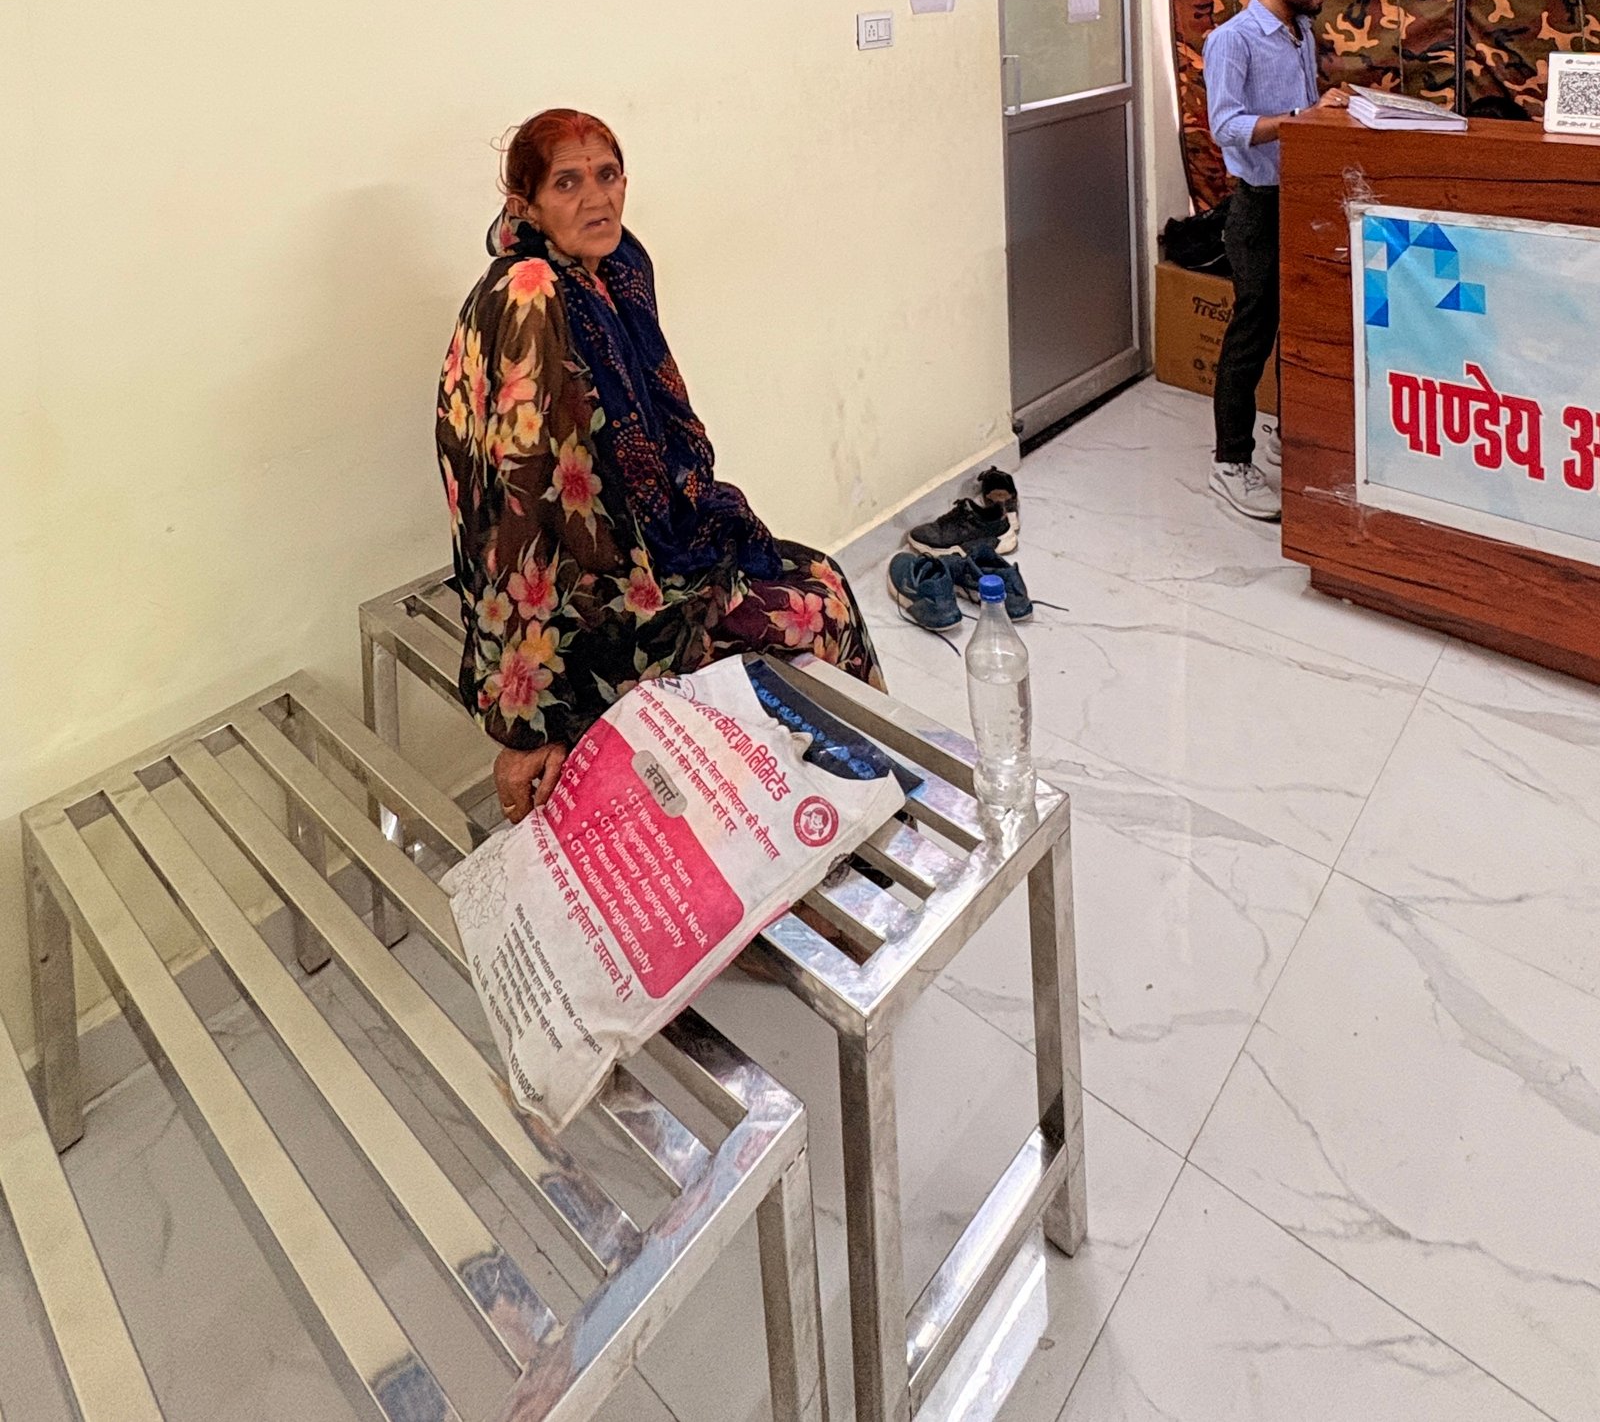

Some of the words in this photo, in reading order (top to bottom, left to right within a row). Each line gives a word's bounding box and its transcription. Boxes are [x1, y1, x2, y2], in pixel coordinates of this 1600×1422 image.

[1388, 362, 1545, 481] पाण्डेय
[644, 763, 679, 807] सेवाएं
[744, 744, 791, 801] लिमिटेड
[691, 745, 710, 767] प्रदेश
[705, 760, 724, 784] जिला
[745, 813, 759, 830] की
[754, 826, 781, 861] सौगात
[713, 801, 730, 821] दरों
[725, 817, 738, 836] पर
[544, 850, 559, 867] की
[628, 793, 643, 809] CT
[638, 807, 658, 835] Whole
[655, 832, 675, 861] Body
[672, 859, 692, 887] Scan
[552, 864, 570, 891] जाँच
[564, 888, 580, 905] की
[585, 828, 600, 844] CT
[594, 843, 616, 873] Renal
[610, 869, 653, 933] Angiography
[600, 816, 615, 833] CT
[609, 831, 642, 878] Pulmonary
[638, 878, 685, 948] Angiography
[614, 805, 629, 820] CT
[622, 821, 663, 877] Angiography
[660, 874, 681, 904] Brain
[678, 902, 689, 914] &
[685, 912, 708, 948] Neck
[567, 901, 603, 945] सुविधाएँ
[571, 839, 585, 856] CT
[579, 855, 613, 902] Peripheral
[606, 900, 653, 974] Angiography
[594, 938, 623, 984] उपलब्ध
[553, 979, 563, 995] Go
[560, 993, 576, 1018] Now
